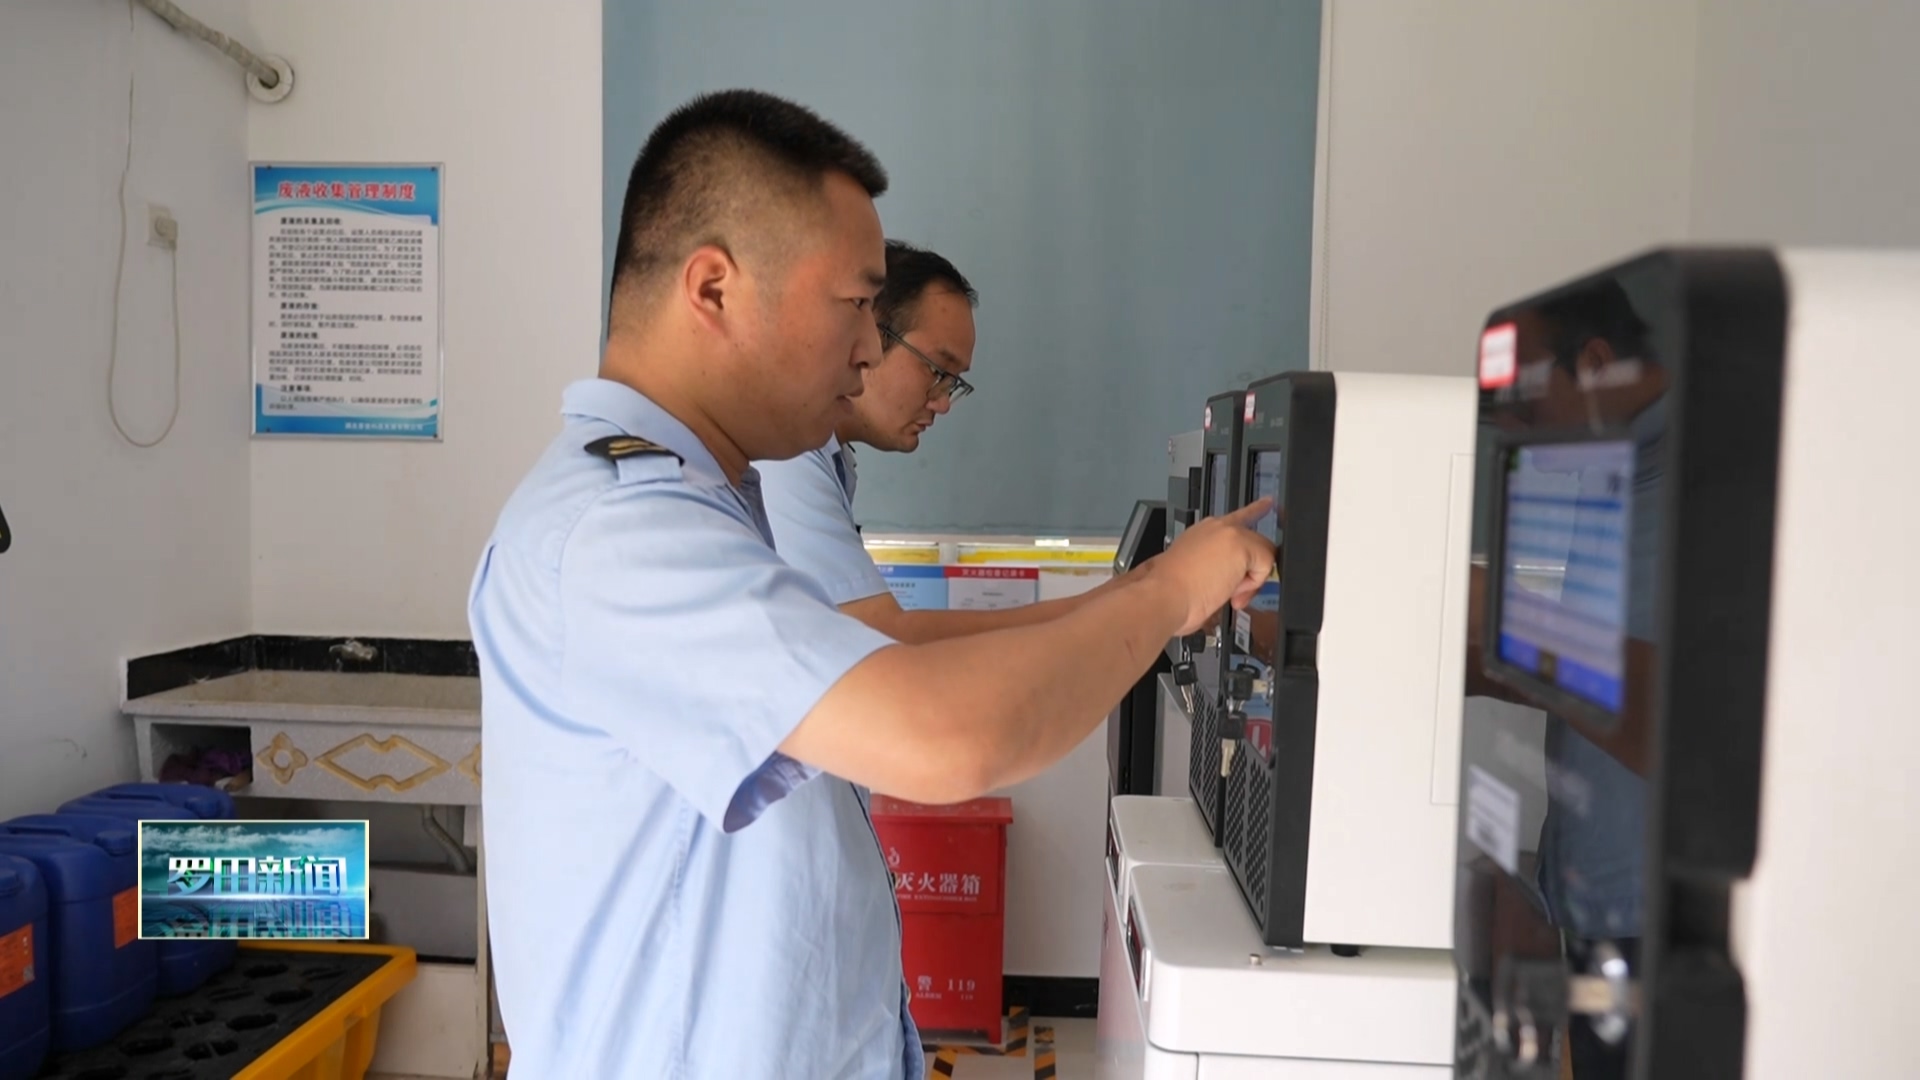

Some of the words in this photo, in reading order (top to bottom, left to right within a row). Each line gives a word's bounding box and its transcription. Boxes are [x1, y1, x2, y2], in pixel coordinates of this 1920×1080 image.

[277, 180, 415, 201] 废液收集管理制度
[896, 872, 981, 895] 灭火器箱
[917, 975, 932, 991] 警
[947, 978, 976, 992] 119
